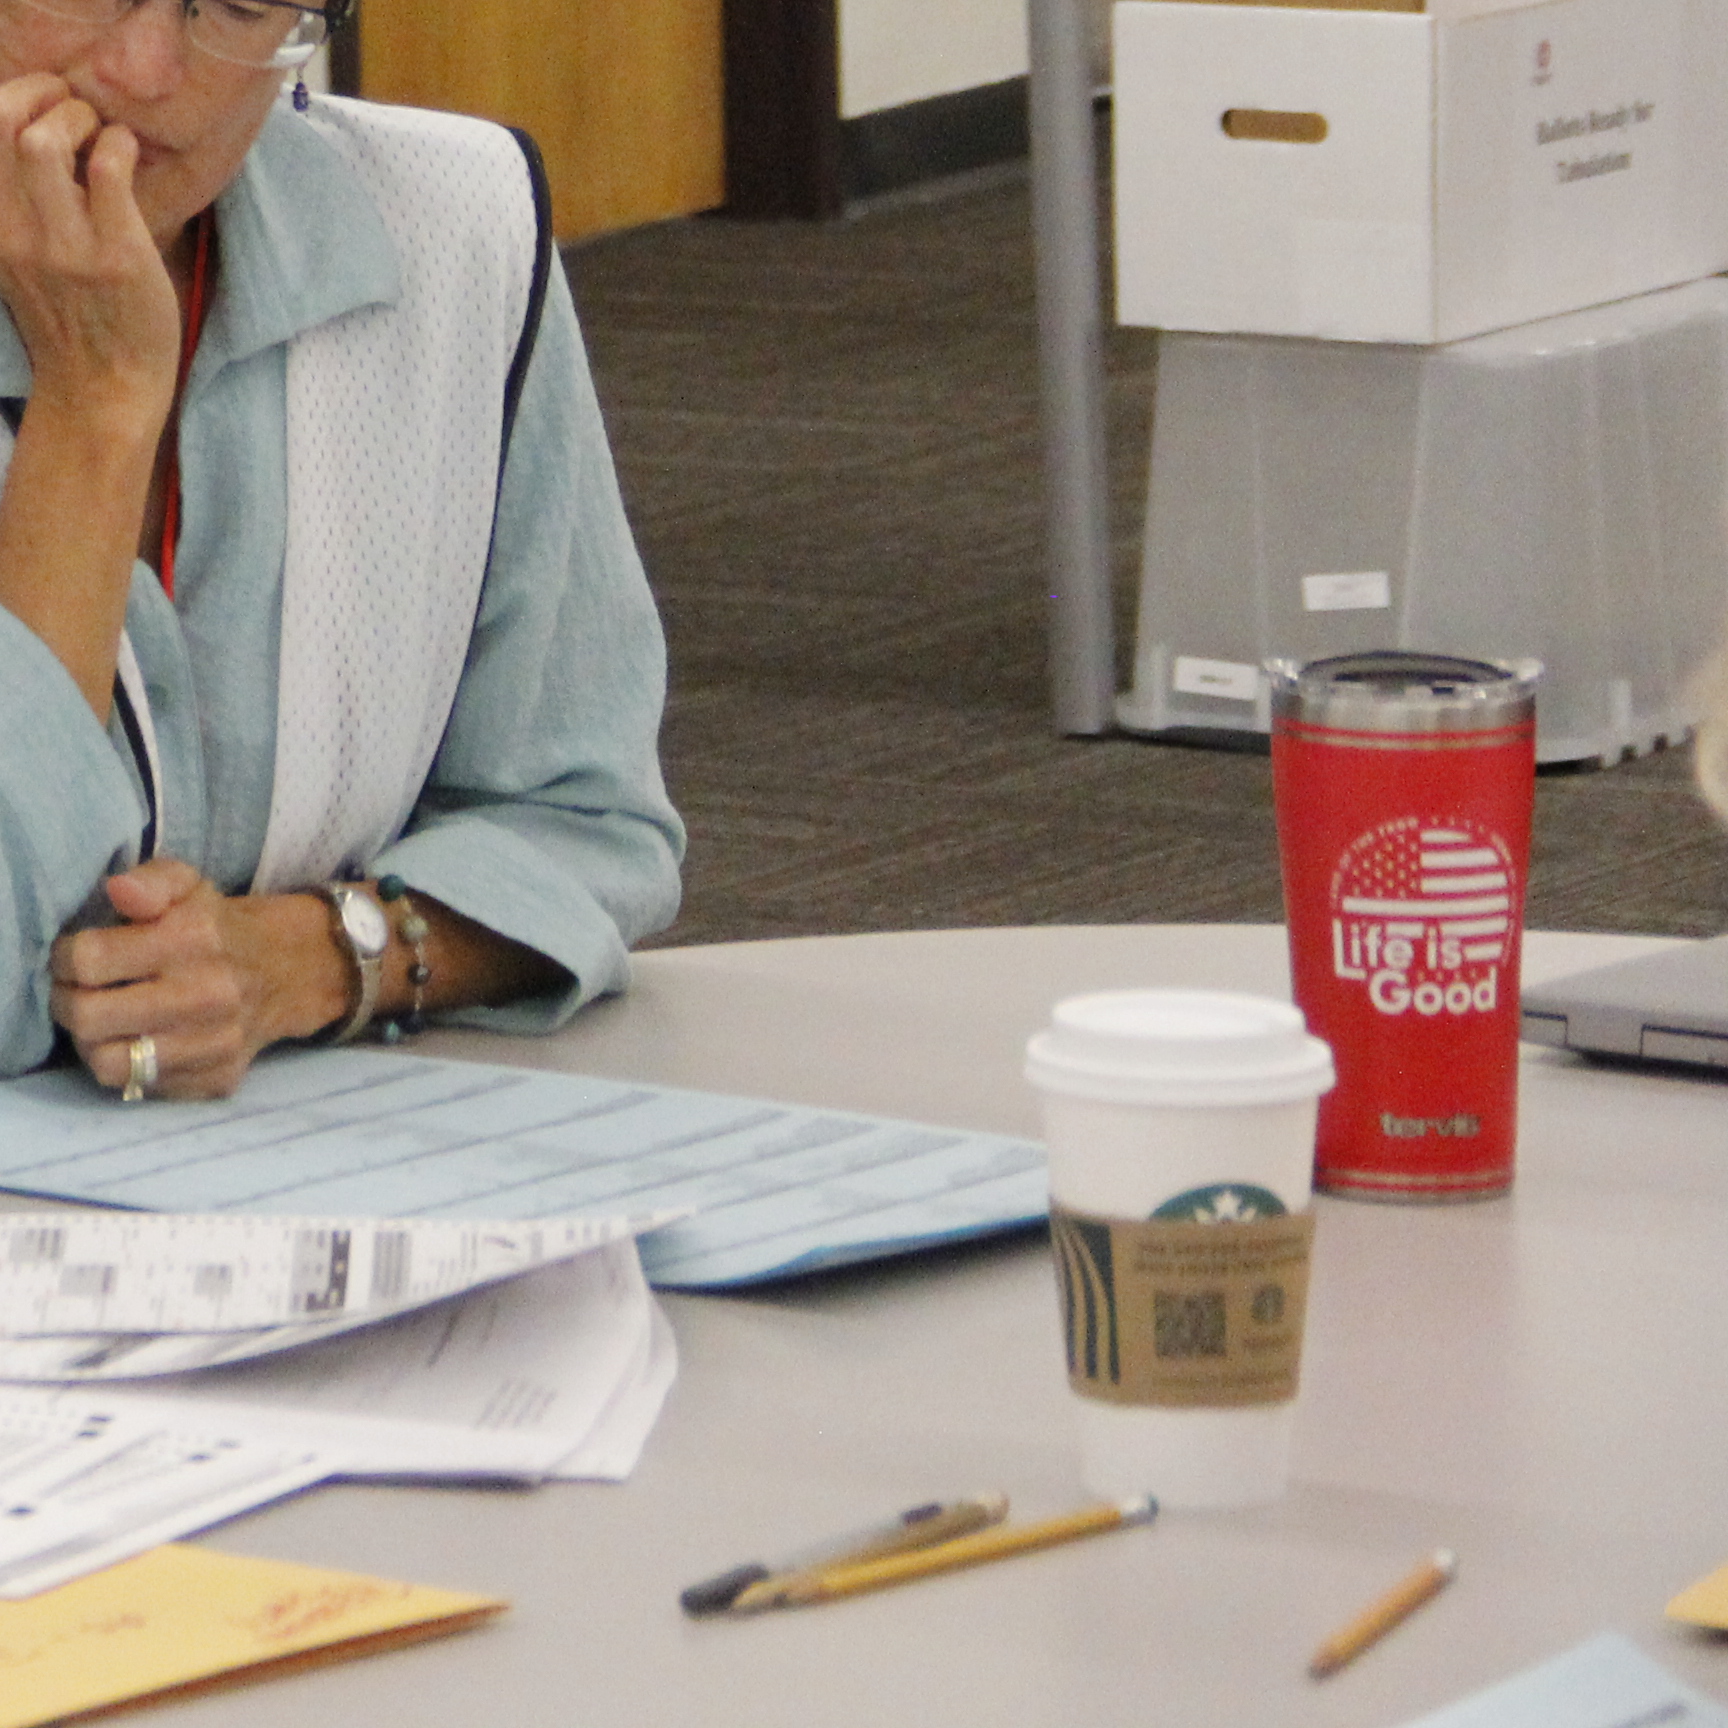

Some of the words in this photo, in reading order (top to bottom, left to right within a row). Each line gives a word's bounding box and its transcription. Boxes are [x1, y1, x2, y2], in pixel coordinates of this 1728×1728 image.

[1332, 919, 1414, 980] Life
[1427, 926, 1462, 970] is
[1369, 966, 1497, 1016] Good
